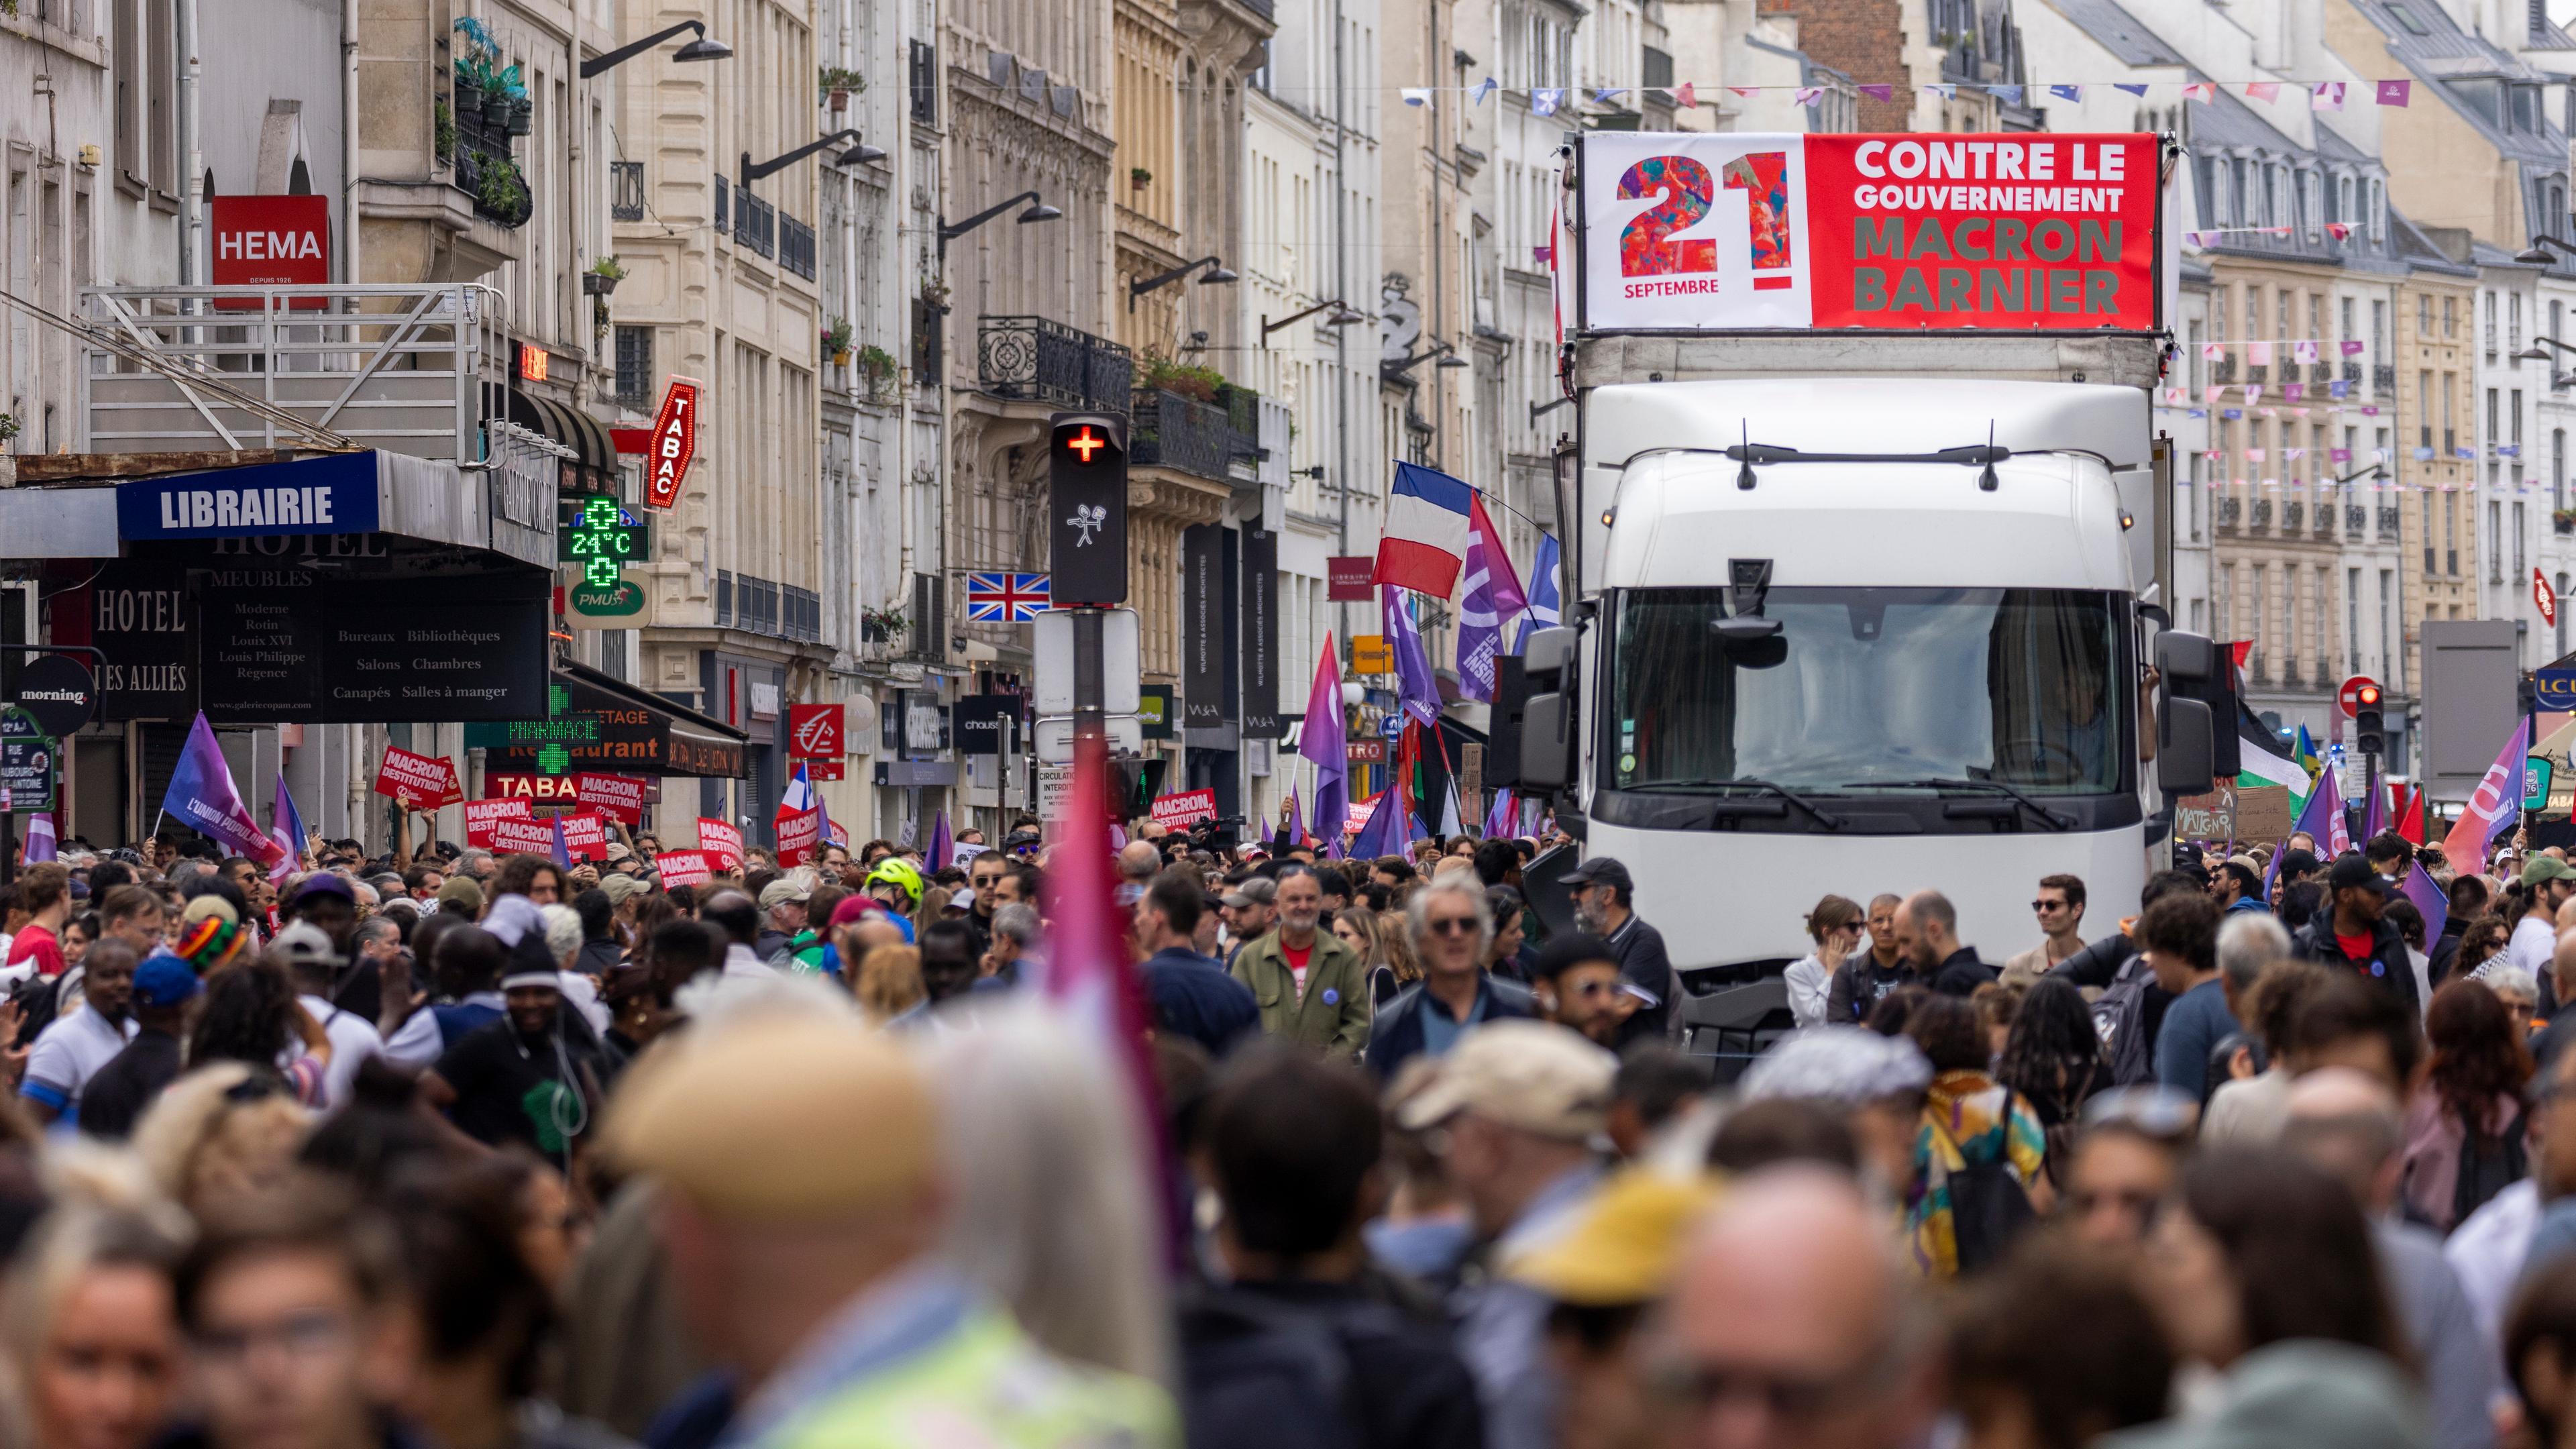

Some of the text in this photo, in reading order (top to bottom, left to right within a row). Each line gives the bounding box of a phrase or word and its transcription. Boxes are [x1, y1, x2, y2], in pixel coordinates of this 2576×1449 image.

[1854, 140, 2125, 181] CONTRE LE
[1854, 184, 2124, 212] GOUVERNEMENT
[220, 231, 322, 260] HEMA
[1854, 216, 2123, 262] MACRON
[1624, 279, 1719, 299] SEPTEMBRE
[1854, 266, 2121, 315] BARNIER
[656, 398, 688, 494] TABAC
[504, 467, 531, 527] GALERIE
[161, 486, 333, 528] LIBRAIRIE
[210, 571, 313, 587] MEUBLES
[579, 594, 612, 606] PMU
[2535, 579, 2553, 615] TABAC
[97, 590, 186, 632] HOTEL
[235, 604, 289, 614] Moderne
[246, 619, 278, 629] Rotin
[231, 635, 292, 645] Louix XVI
[338, 630, 500, 645] Bureaux Bibliothèques
[1485, 632, 1499, 647] LA
[219, 651, 306, 665] Louis Philippe
[356, 657, 482, 670] Salons Chambres
[1472, 640, 1497, 671] FRA
[129, 663, 186, 691] ALLIÉS
[237, 667, 288, 681] Régence
[1463, 655, 1495, 693] INSOU
[333, 686, 508, 702] Canapés Salles à manger
[213, 701, 311, 711] www.galeriecopam.com
[509, 720, 598, 739] PHARMACIE
[8, 745, 23, 755] RUE
[509, 738, 657, 757] Reaurant
[1347, 743, 1379, 759] TRO
[1, 767, 34, 777] AUBOURG
[386, 751, 447, 784] MACRON,
[382, 766, 445, 793] DESTITUTION!
[498, 777, 577, 798] TABA
[582, 777, 642, 798] MACRON,
[2526, 784, 2536, 792] 76
[580, 792, 641, 809] DESTITUTION!
[1153, 794, 1214, 816] MACRON,
[2547, 796, 2574, 808] TABA
[467, 802, 530, 820] MACRON,
[186, 798, 268, 849] L'UNION POPULAIRE
[562, 816, 601, 835] CRON,
[2175, 806, 2232, 838] MATIGNON
[496, 821, 553, 843] MACRON
[564, 833, 603, 847] TUTION!
[495, 838, 552, 855] DESTITUTION
[658, 855, 709, 875] MACRON,
